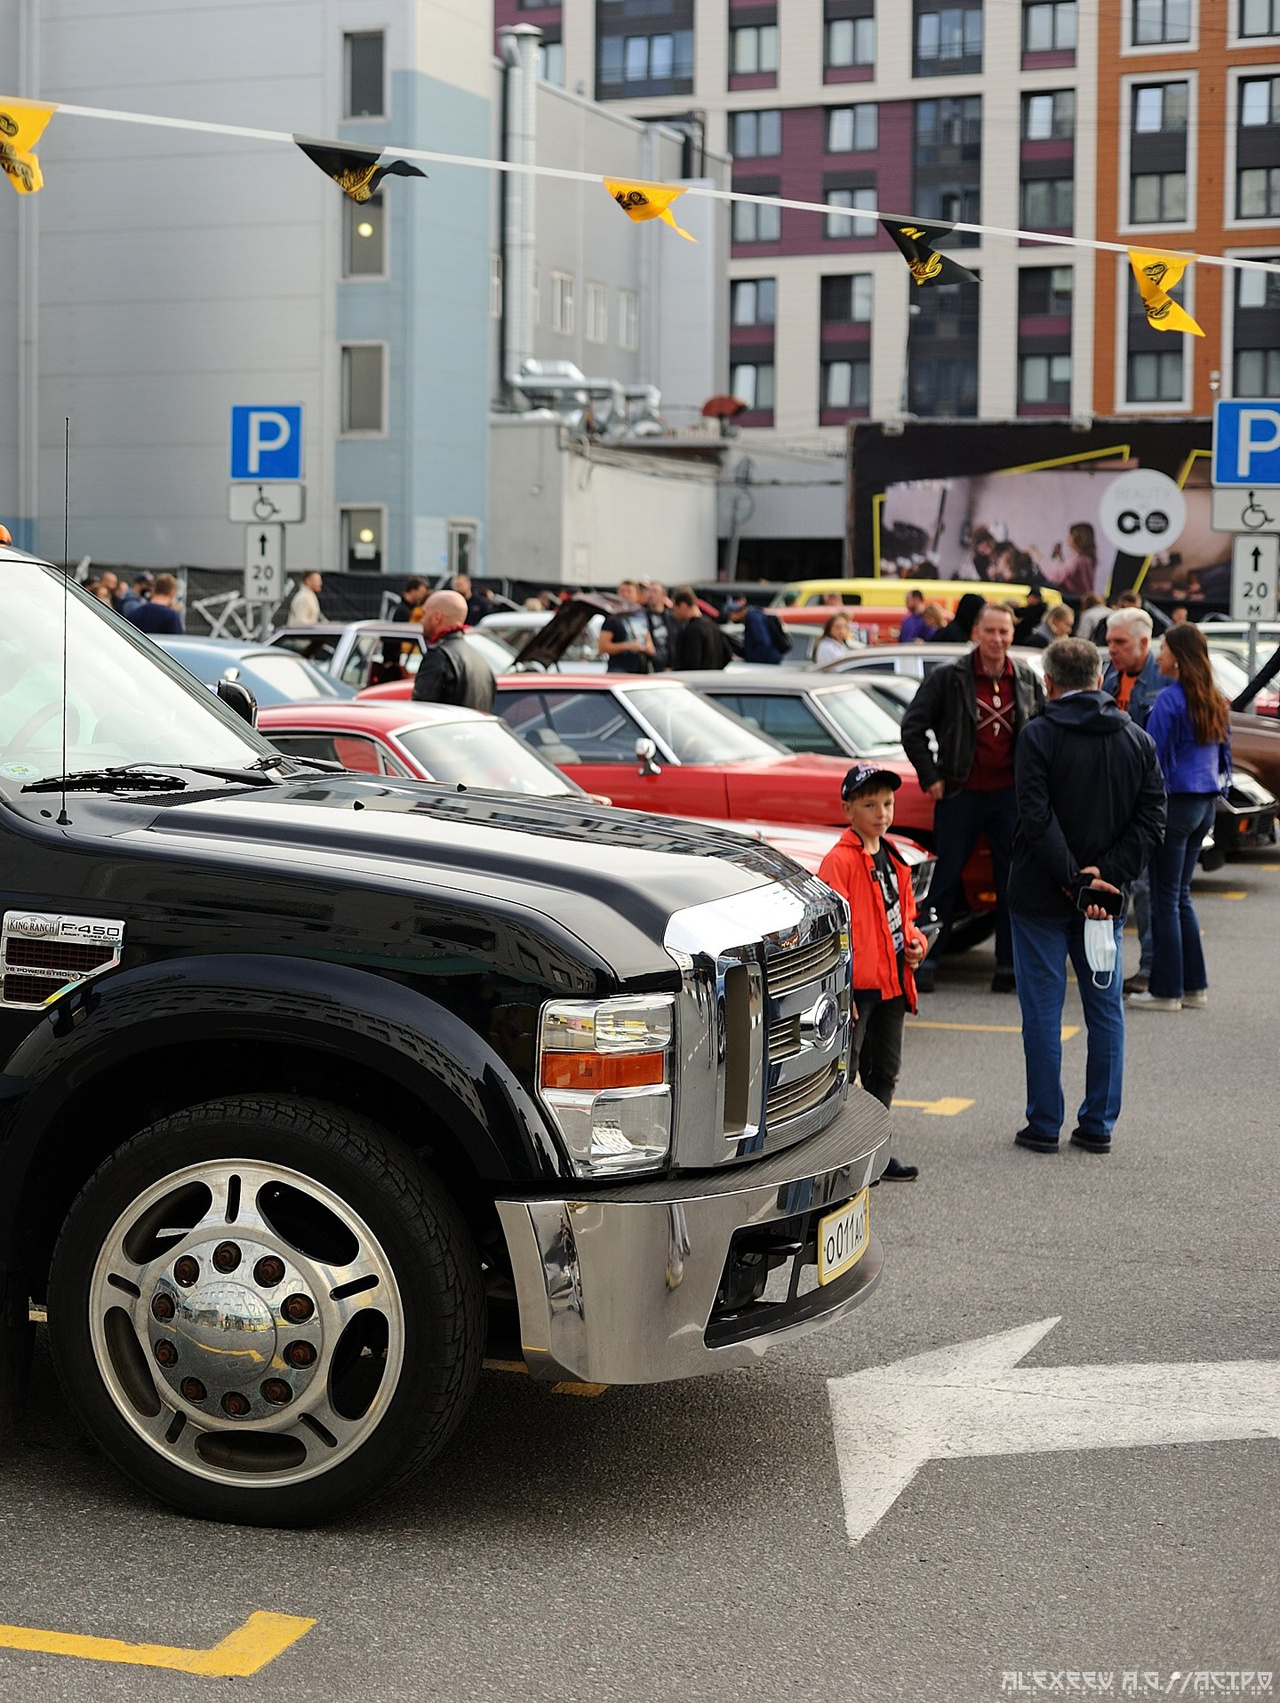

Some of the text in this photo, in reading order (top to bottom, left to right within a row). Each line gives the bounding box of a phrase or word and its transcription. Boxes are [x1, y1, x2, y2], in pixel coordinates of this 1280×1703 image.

[247, 411, 291, 474] P
[1237, 408, 1280, 477] P
[252, 565, 273, 580] 20
[1243, 582, 1268, 599] 20
[9, 919, 55, 933] KING RANCH
[61, 923, 120, 937] F-450
